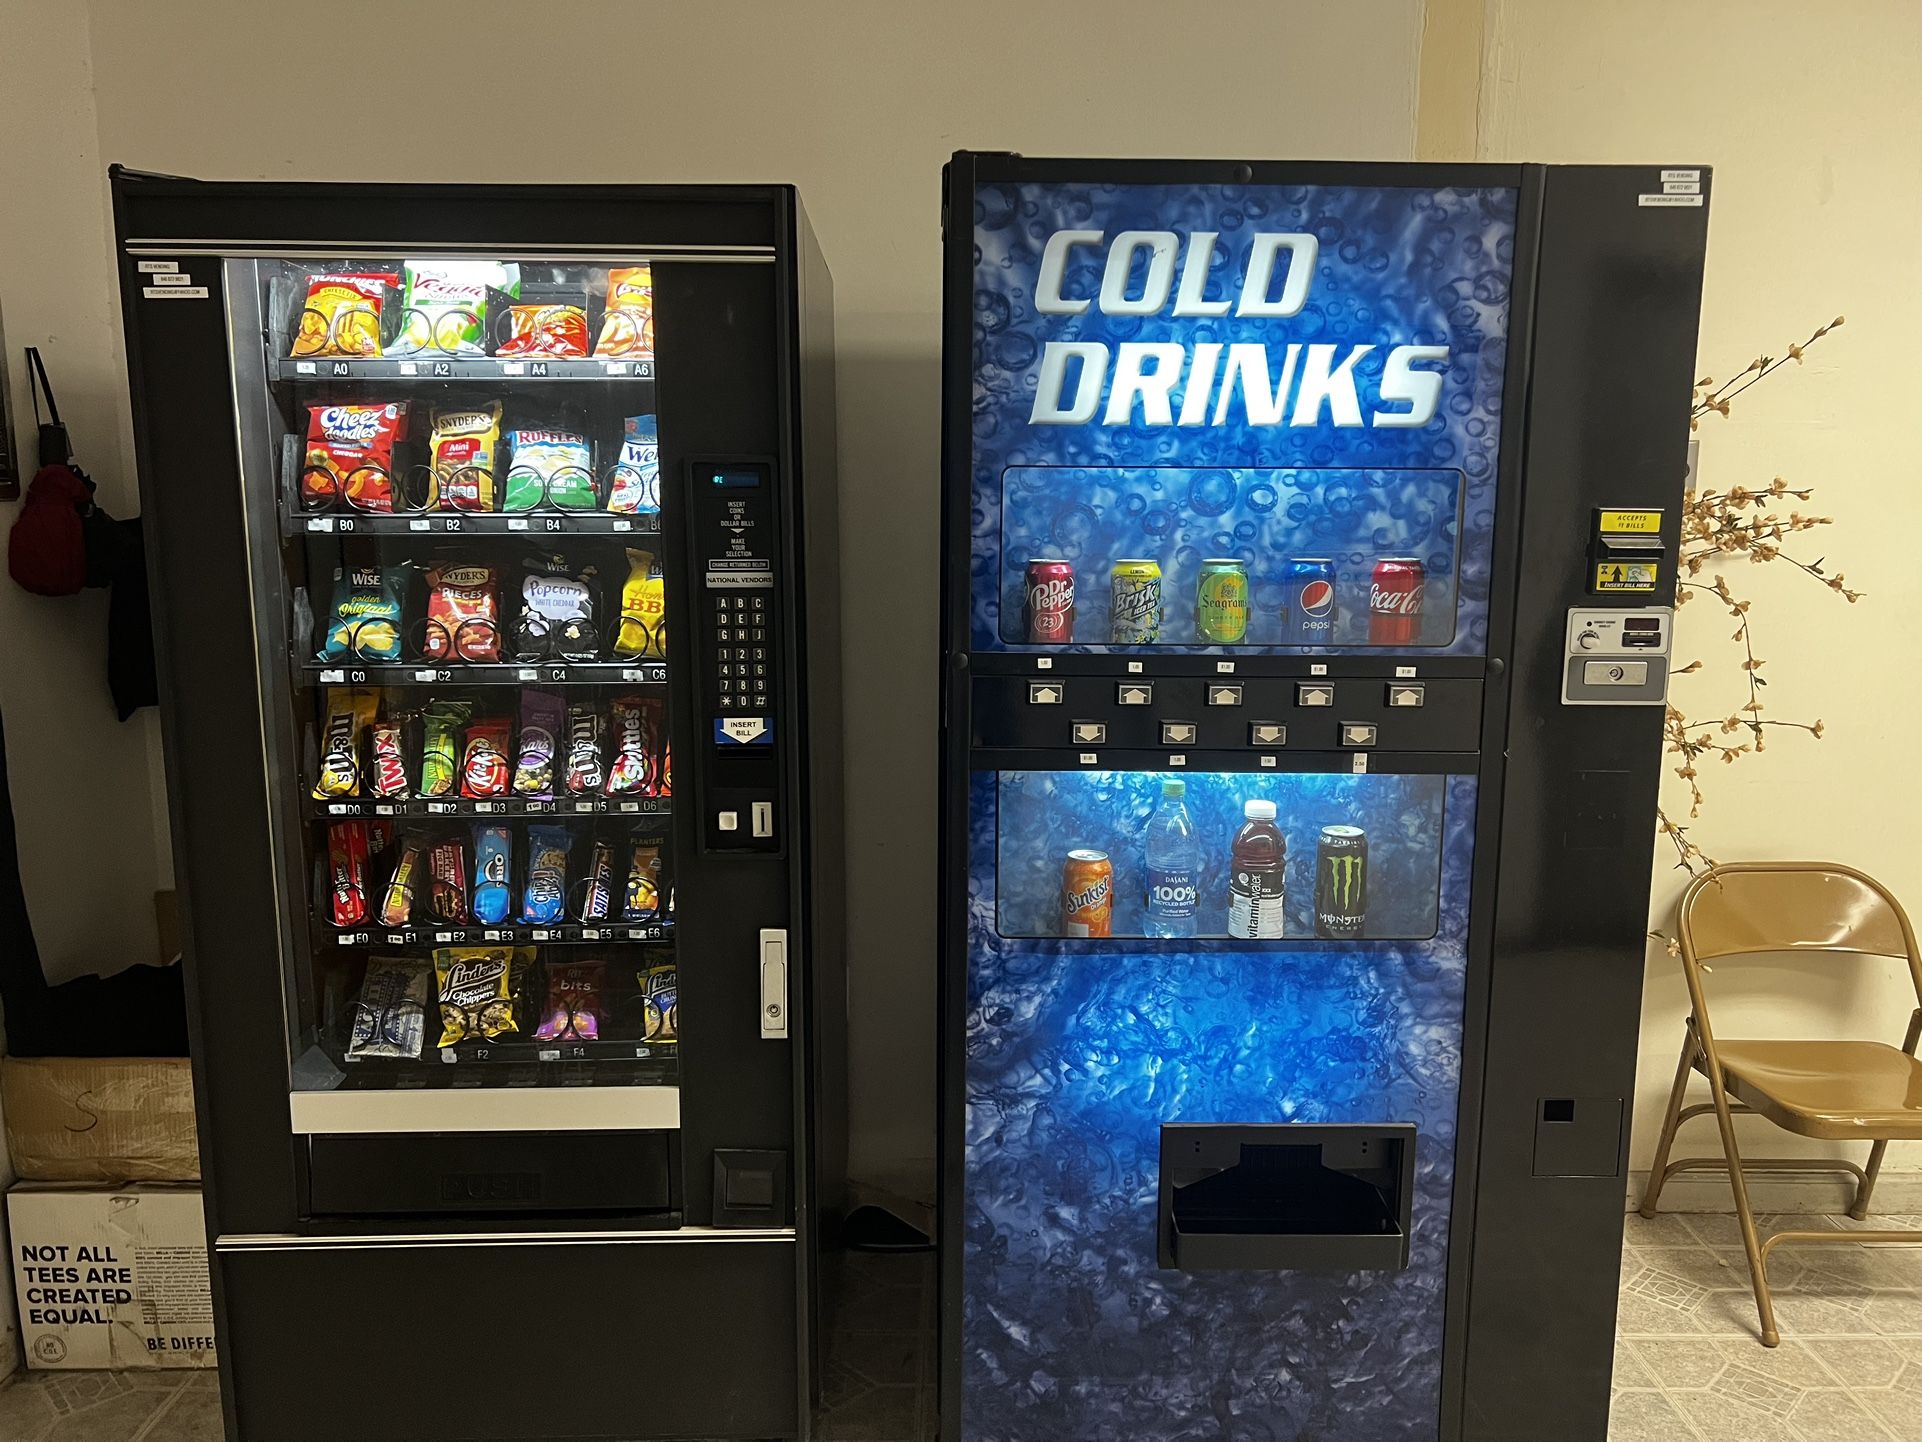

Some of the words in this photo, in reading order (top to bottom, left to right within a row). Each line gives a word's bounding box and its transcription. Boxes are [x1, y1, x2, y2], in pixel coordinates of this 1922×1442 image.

[1034, 230, 1319, 318] COLD
[334, 364, 348, 375] A0
[434, 364, 449, 375] A2
[532, 364, 547, 375] A4
[634, 364, 649, 375] A6
[1028, 341, 1450, 428] DRINKS
[320, 406, 382, 429] Cheez
[449, 441, 469, 452] Mini
[340, 520, 354, 531] B0
[446, 520, 461, 531] B2
[546, 520, 560, 531] B4
[547, 562, 570, 572] WISE
[352, 573, 381, 586] WISE
[444, 570, 486, 581] NYDER'S
[530, 580, 583, 598] Popcorn
[1050, 579, 1067, 594] Dr
[442, 587, 482, 600] PIECES
[1034, 581, 1074, 611] Pepper
[351, 595, 381, 604] golden
[720, 598, 727, 608] A
[738, 598, 744, 608] B
[755, 598, 761, 608] C
[721, 614, 727, 624] D
[738, 614, 744, 624] E
[755, 614, 761, 624] F
[1041, 616, 1055, 628] 23
[1302, 620, 1331, 631] pepsi
[721, 630, 728, 640] G
[738, 630, 745, 640] H
[757, 630, 761, 640] J
[723, 650, 727, 659] 1
[740, 650, 745, 659] 2
[757, 650, 762, 659] 3
[437, 670, 451, 681] C2
[552, 670, 566, 681] C4
[652, 669, 666, 680] C6
[722, 665, 728, 675] 4
[740, 665, 746, 675] 5
[757, 665, 763, 675] 6
[352, 671, 365, 682] C0
[723, 681, 729, 690] 7
[740, 681, 746, 690] 8
[757, 681, 763, 690] 9
[741, 696, 747, 706] 0
[347, 805, 361, 815] D0
[395, 805, 408, 815] D1
[443, 804, 457, 814] D2
[493, 802, 506, 812] D3
[543, 802, 556, 812] D4
[594, 801, 607, 811] D5
[644, 801, 657, 811] D6
[1165, 876, 1189, 884] DASANI
[1067, 874, 1110, 914] Sunkist
[1153, 885, 1196, 901] 100%
[1247, 873, 1262, 938] vitaminwater
[357, 933, 369, 944] E0
[406, 933, 417, 943] E1
[453, 932, 466, 942] E2
[502, 931, 514, 941] E3
[550, 930, 562, 940] E4
[600, 929, 612, 939] E5
[648, 928, 660, 938] E6
[560, 979, 591, 991] bits
[453, 983, 495, 1000] Chocolate
[457, 991, 495, 1006] Chippers
[478, 1049, 489, 1060] F2
[573, 1047, 585, 1058] F4
[22, 1245, 69, 1262] NOT
[76, 1246, 118, 1262] ALL
[23, 1267, 80, 1284] TEES
[86, 1267, 132, 1284] ARE
[26, 1288, 132, 1305] CREATED
[30, 1309, 114, 1325] EQUAL.
[147, 1337, 167, 1350] BE
[171, 1336, 215, 1350] DIFFE
